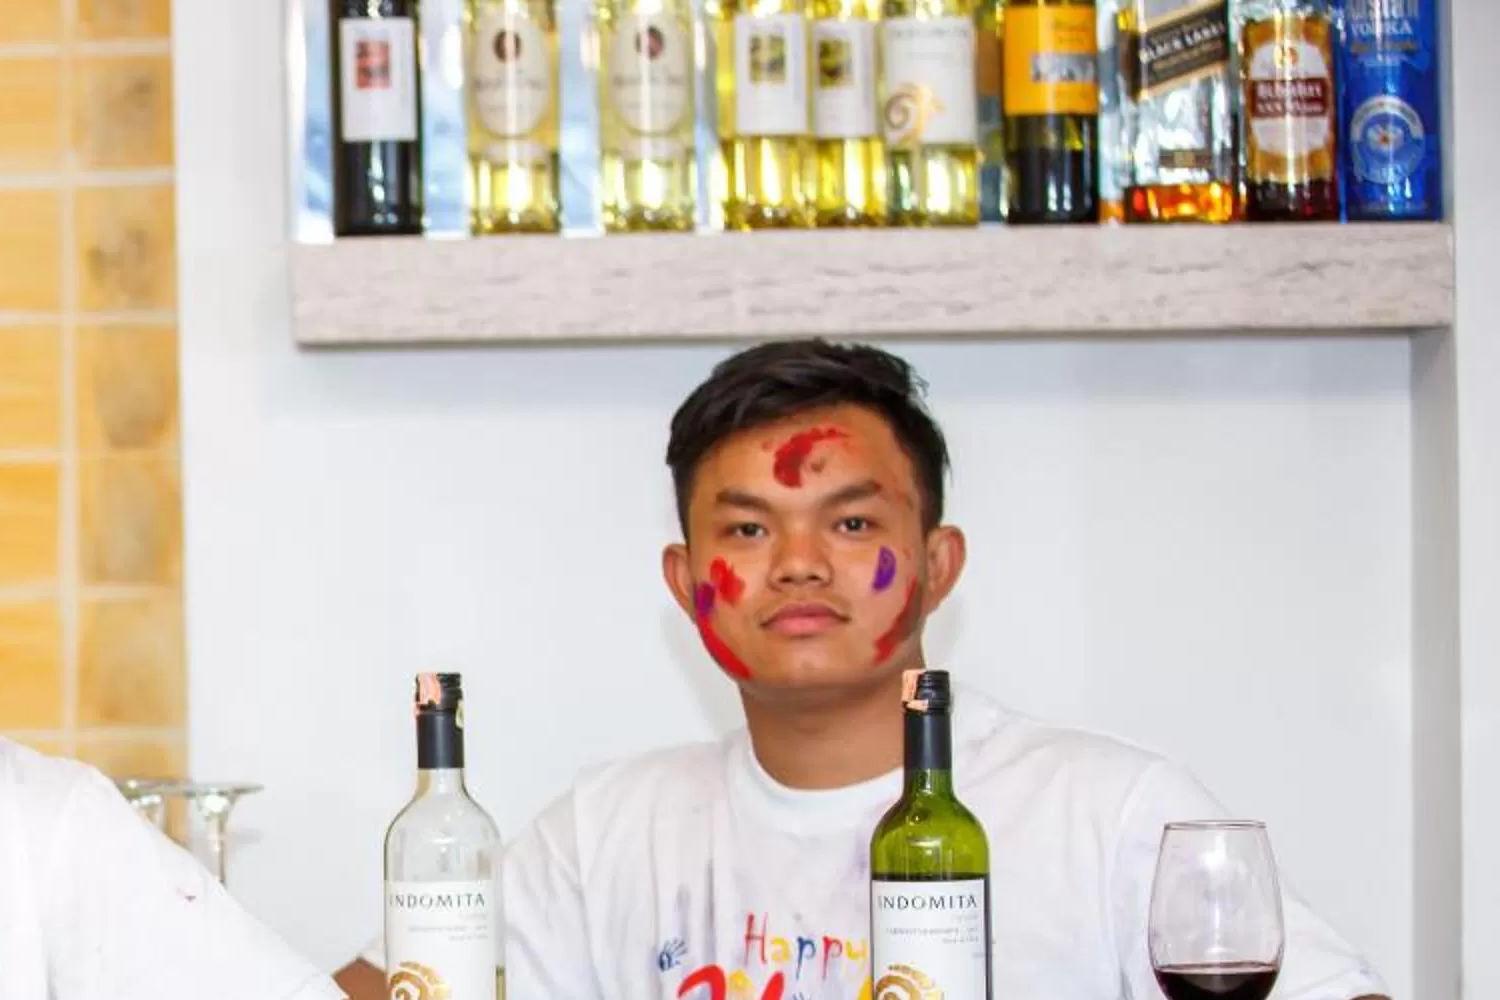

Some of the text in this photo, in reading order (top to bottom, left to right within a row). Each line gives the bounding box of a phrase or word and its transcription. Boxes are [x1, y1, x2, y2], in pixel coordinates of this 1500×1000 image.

[1140, 37, 1183, 64] BLACK
[387, 892, 486, 909] INDOMITA
[877, 894, 978, 910] INDOMITA
